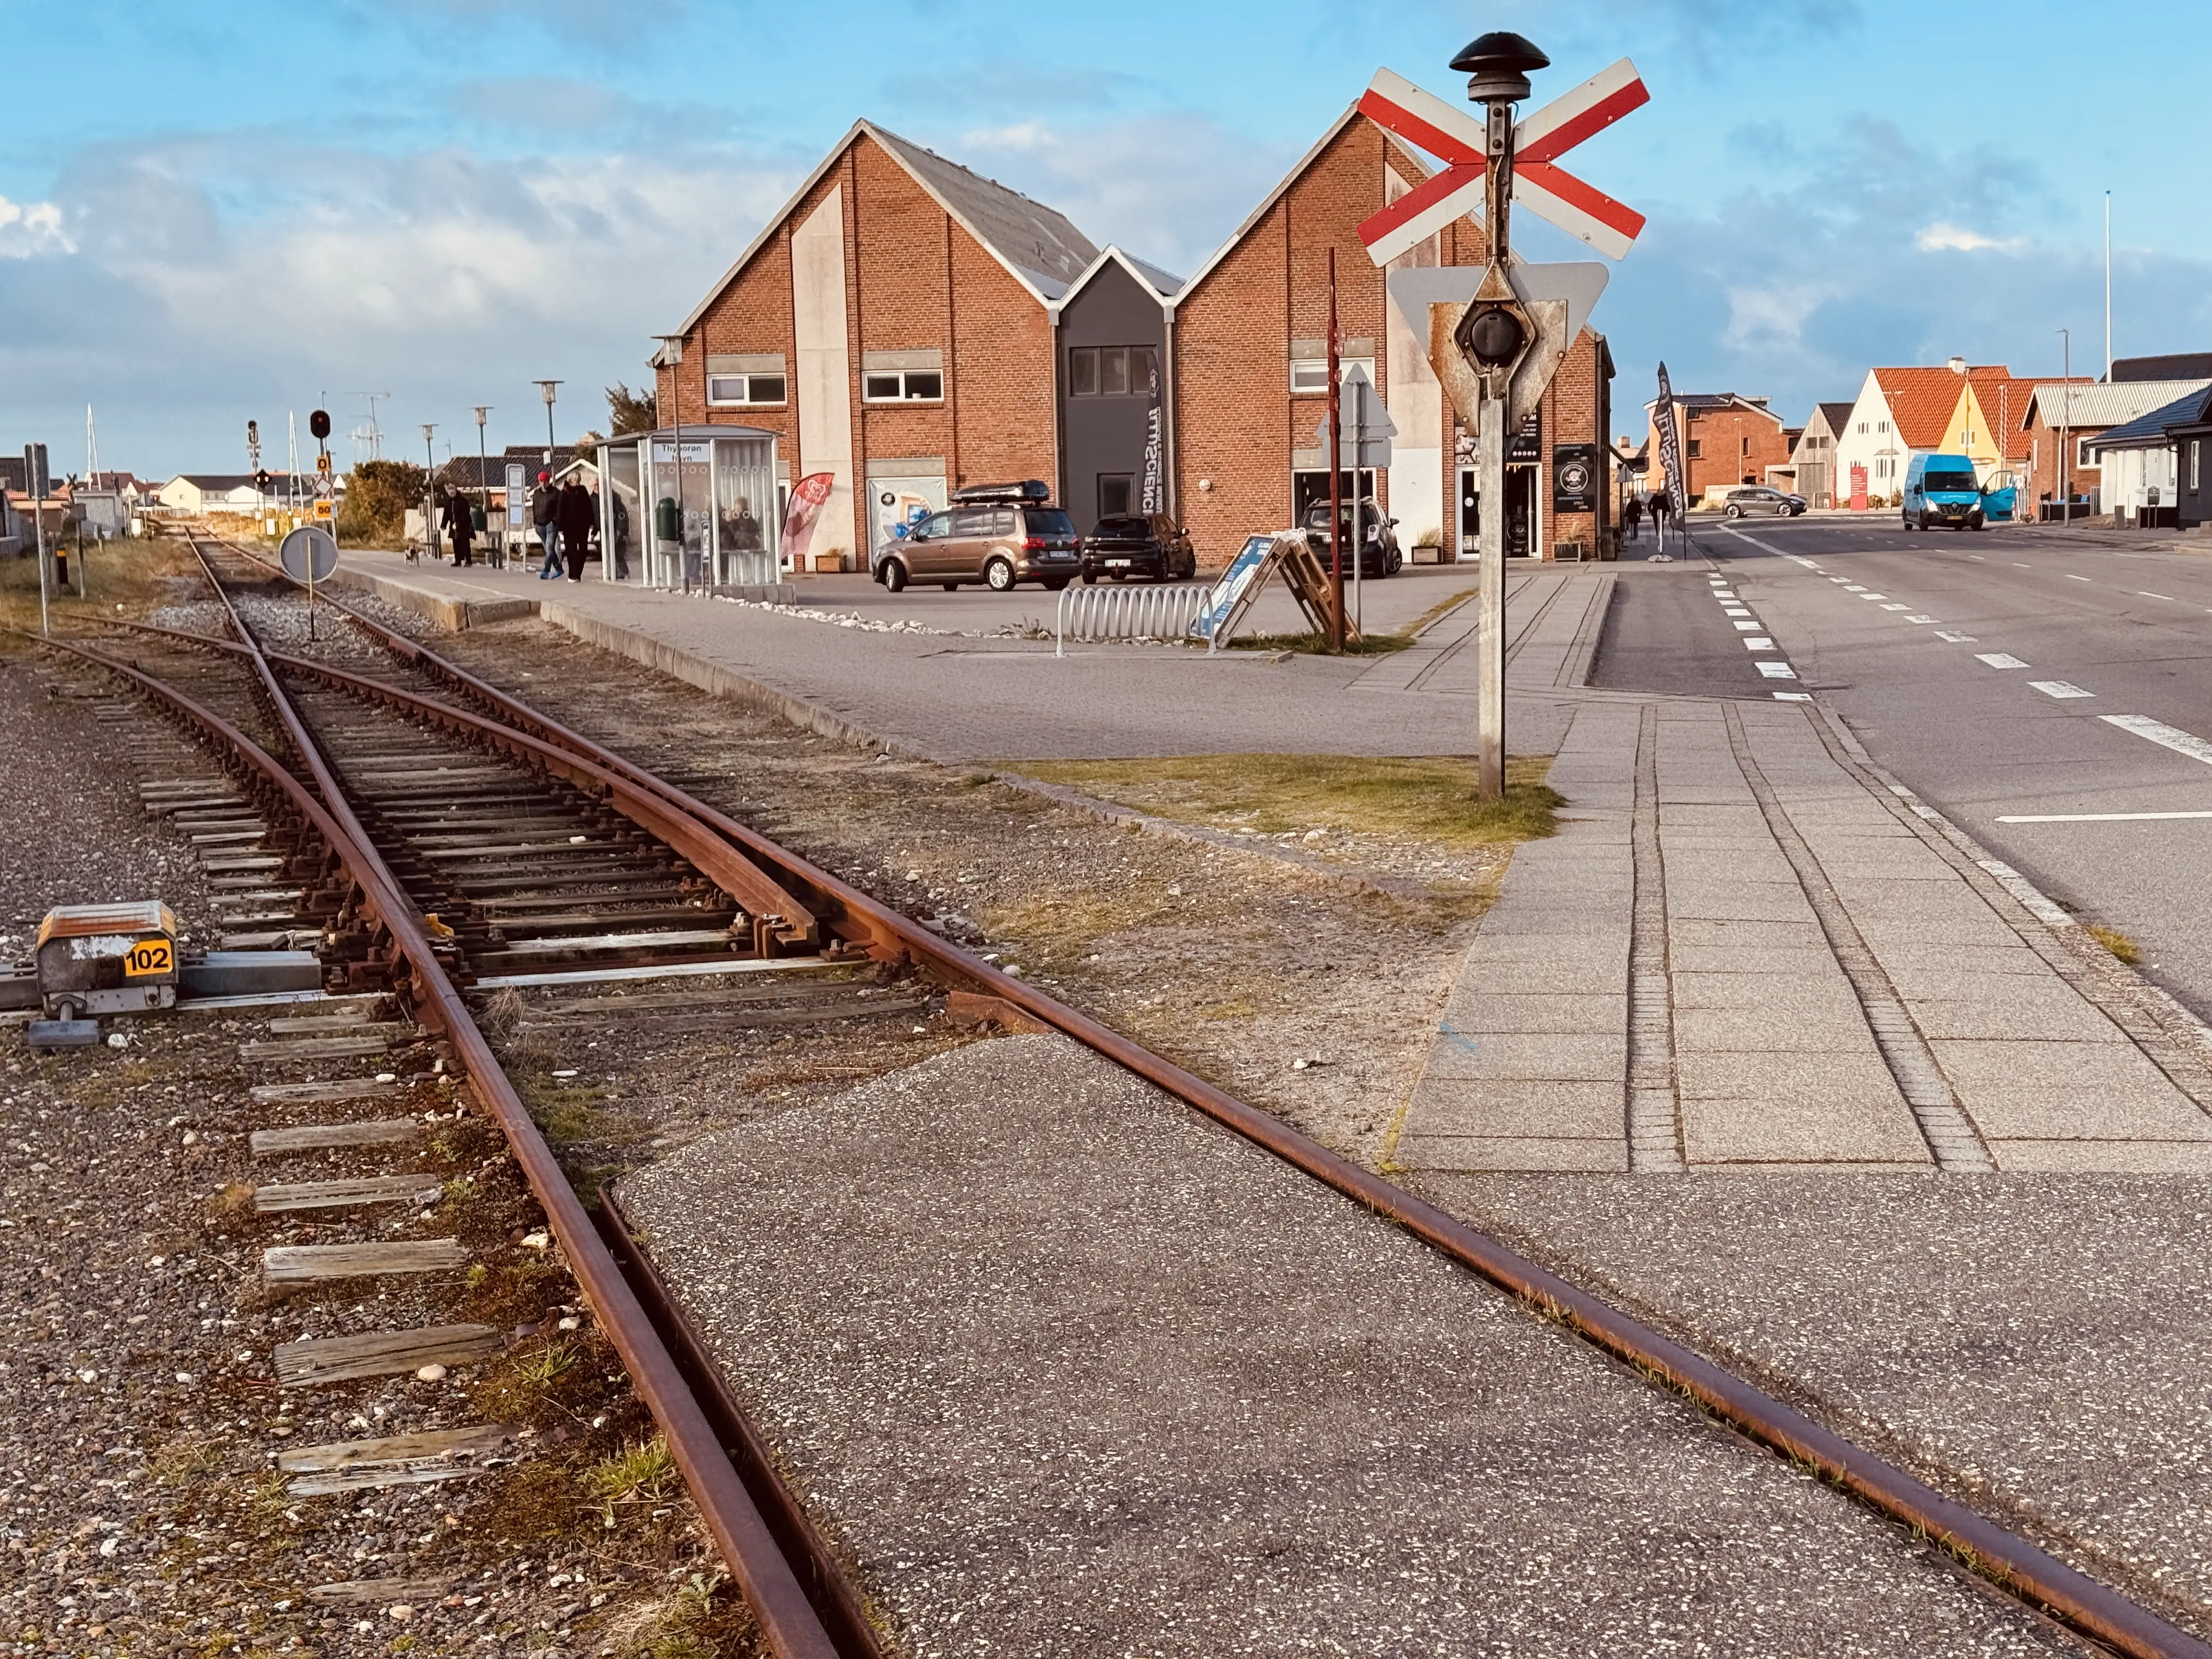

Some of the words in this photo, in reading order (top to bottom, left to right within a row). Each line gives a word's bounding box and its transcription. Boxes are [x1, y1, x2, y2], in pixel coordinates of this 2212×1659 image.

[662, 444, 702, 453] Thyorøn
[318, 459, 327, 469] 0
[126, 947, 168, 971] 102
